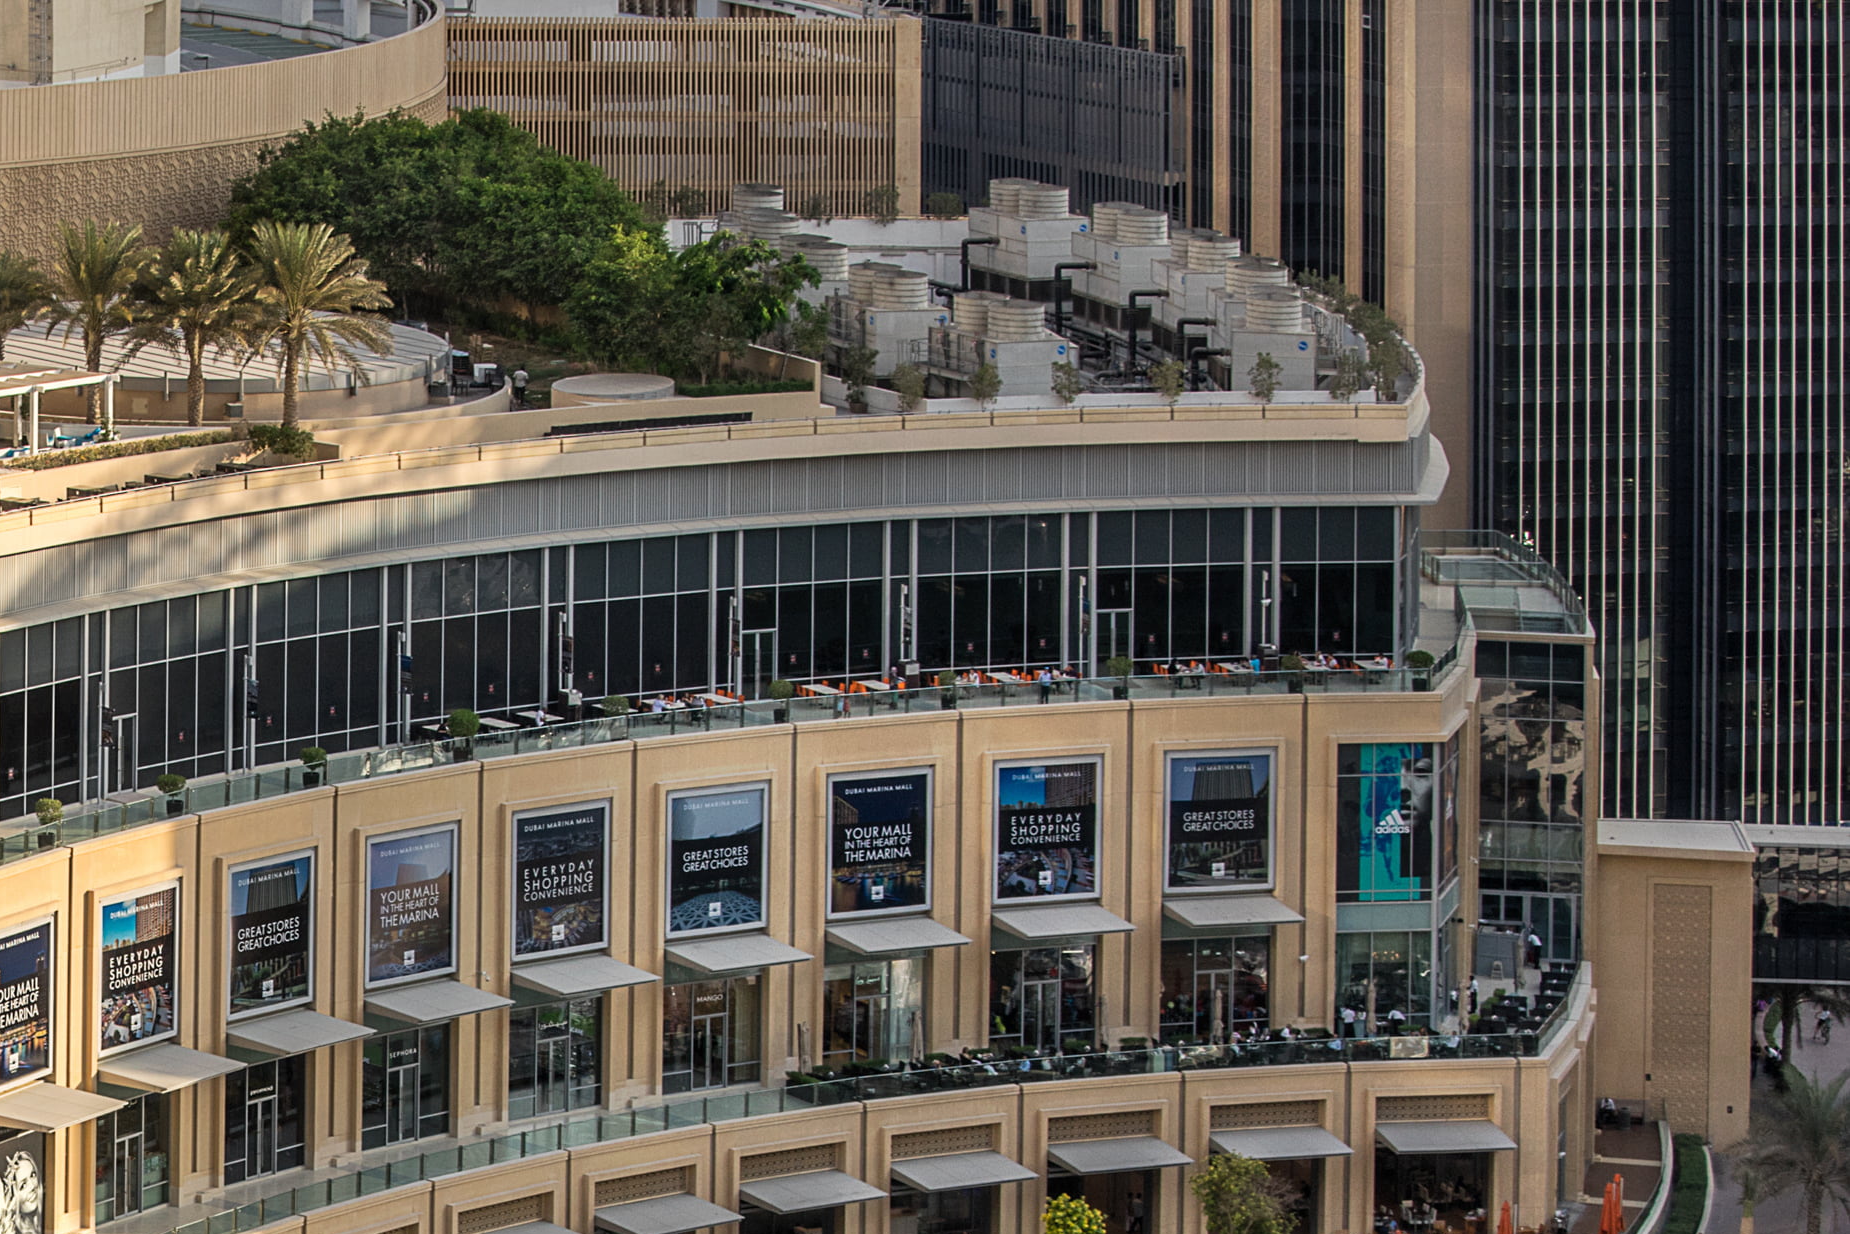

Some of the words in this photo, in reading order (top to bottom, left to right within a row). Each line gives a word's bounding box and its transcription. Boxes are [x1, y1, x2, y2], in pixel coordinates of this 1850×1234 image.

[524, 824, 545, 832] DUBAI
[546, 820, 574, 829] MARINA
[576, 816, 594, 824] MALL
[1011, 812, 1081, 825] EVERYDAY
[1183, 812, 1216, 822] GREAT
[1217, 810, 1254, 820] STORES
[845, 826, 879, 840] YOUR
[881, 823, 912, 836] MALL
[1011, 822, 1081, 836] SHOPPING
[1183, 822, 1212, 832] GREAT
[1213, 820, 1254, 831] CHOICES
[1375, 826, 1410, 834] adidas
[844, 841, 855, 850] IN
[856, 839, 871, 848] THE
[872, 836, 898, 847] HEART
[899, 835, 912, 845] OF
[1010, 833, 1081, 845] CONVENIENCE
[683, 849, 712, 862] GREAT
[714, 845, 749, 858] STORES
[844, 850, 865, 863] THE
[866, 846, 912, 861] MARINA
[524, 859, 594, 879] EVERYDAY
[683, 860, 710, 872] GREAT
[710, 856, 748, 869] CHOICES
[238, 878, 256, 887] DUBAI
[258, 871, 282, 882] MARINA
[284, 868, 300, 877] MALL
[524, 871, 593, 892] SHOPPING
[380, 889, 410, 904] YOUR
[412, 883, 440, 898] MALL
[524, 883, 593, 902] CONVENIENCE
[380, 905, 389, 914] IN
[390, 902, 403, 912] THE
[405, 898, 427, 910] HEART
[429, 895, 439, 906] OF
[380, 914, 398, 928] THE
[399, 907, 439, 925] MARINA
[238, 924, 265, 940] GREAT
[267, 916, 300, 934] STORES
[238, 937, 263, 952] GREAT
[263, 929, 300, 947] CHOICES
[110, 944, 164, 968] EVERYDAY
[110, 956, 163, 980] SHOPPING
[16, 977, 39, 996] MALL
[109, 967, 163, 990] CONVENIENCE
[0, 1002, 10, 1014] THE
[11, 994, 29, 1010] HEART
[30, 991, 39, 1003] OF
[696, 994, 723, 1002] MANGO
[5, 1003, 39, 1027] MARINA
[390, 1048, 417, 1058] SEPHORA
